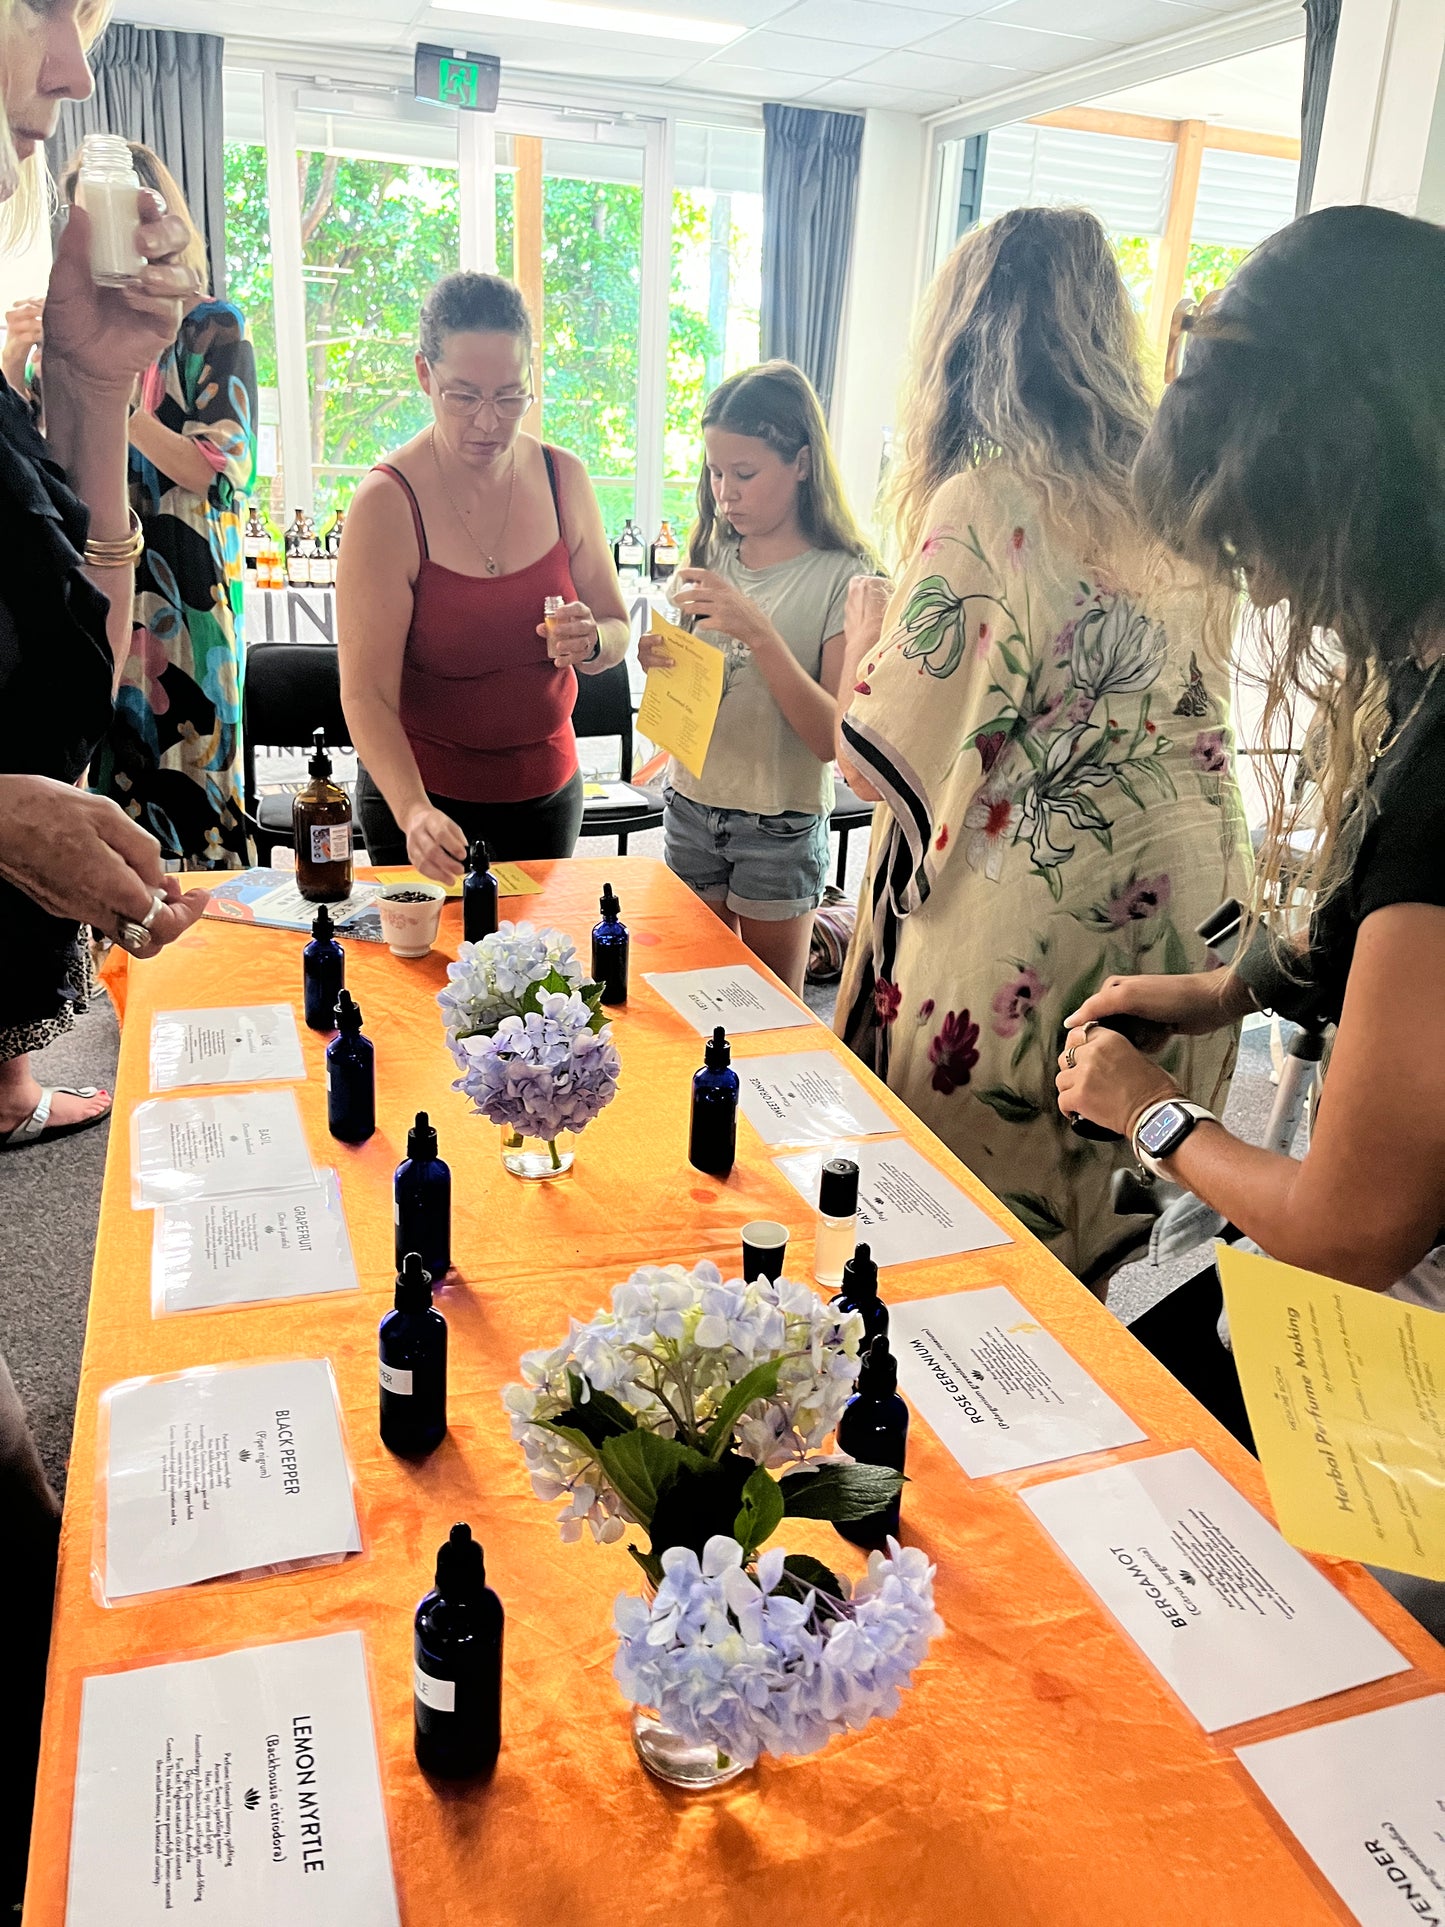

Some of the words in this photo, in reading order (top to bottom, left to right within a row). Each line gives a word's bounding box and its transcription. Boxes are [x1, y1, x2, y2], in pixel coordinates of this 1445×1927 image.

[748, 1077, 772, 1100] ORANGE
[765, 1100, 785, 1118] SWEET
[258, 1128, 271, 1144] BASIL
[292, 1205, 312, 1252] GRAPEFRUIT
[1286, 1306, 1306, 1368] Making
[909, 1338, 959, 1393] GERANIUM
[275, 1410, 293, 1446] BLACK
[952, 1393, 984, 1424] ROSE
[1302, 1376, 1331, 1445] Perfume
[252, 1430, 267, 1450] (Piper
[254, 1452, 271, 1478] nigrum)
[280, 1449, 300, 1494] PEPPER
[1325, 1449, 1353, 1512] Herbal
[1108, 1543, 1187, 1629] BERGAMOT
[1136, 1544, 1177, 1586] bergamia)
[1170, 1585, 1202, 1616] (Citrus
[265, 1733, 282, 1799] (Backhousia
[292, 1714, 315, 1785] LEMON
[271, 1801, 287, 1862] citriodora)
[298, 1790, 324, 1873] MYRTLE
[1362, 1838, 1442, 1927] VENDER
